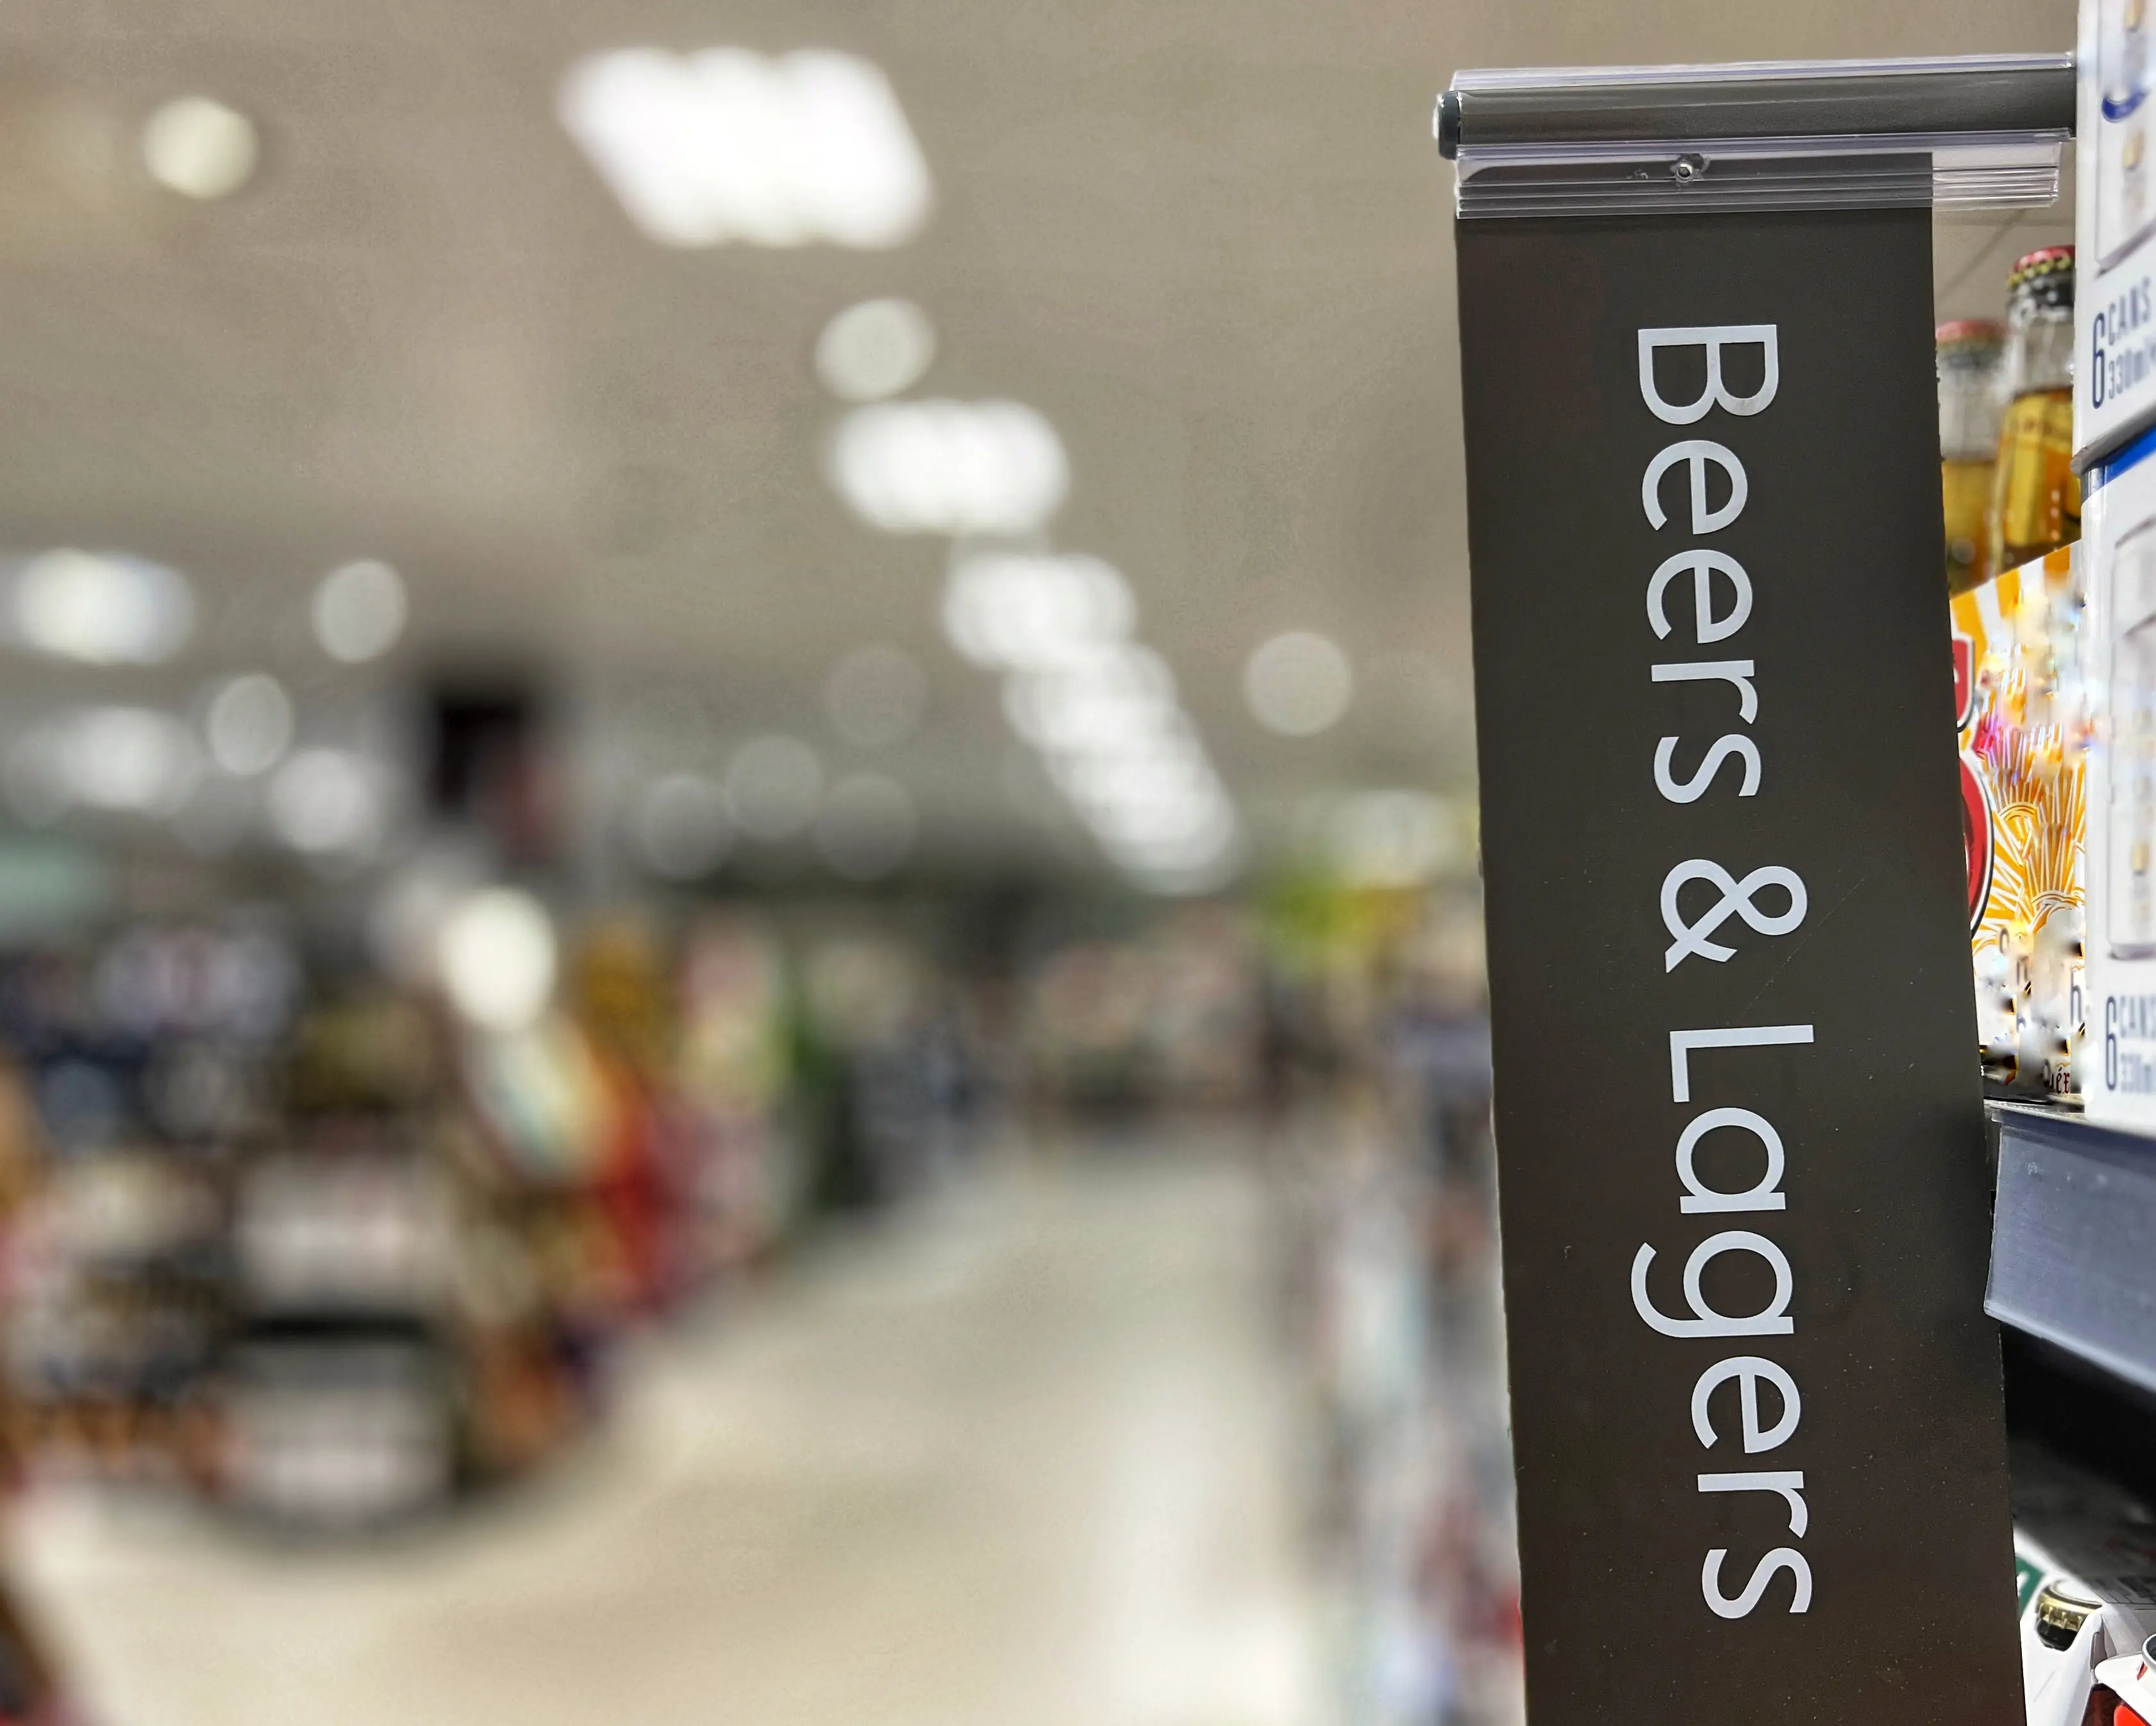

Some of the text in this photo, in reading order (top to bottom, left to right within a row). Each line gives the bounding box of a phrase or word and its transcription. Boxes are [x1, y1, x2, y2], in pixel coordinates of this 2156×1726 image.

[2092, 312, 2105, 409] 6
[1631, 325, 1814, 1618] Beers & Lagers
[2106, 996, 2117, 1091] 6
